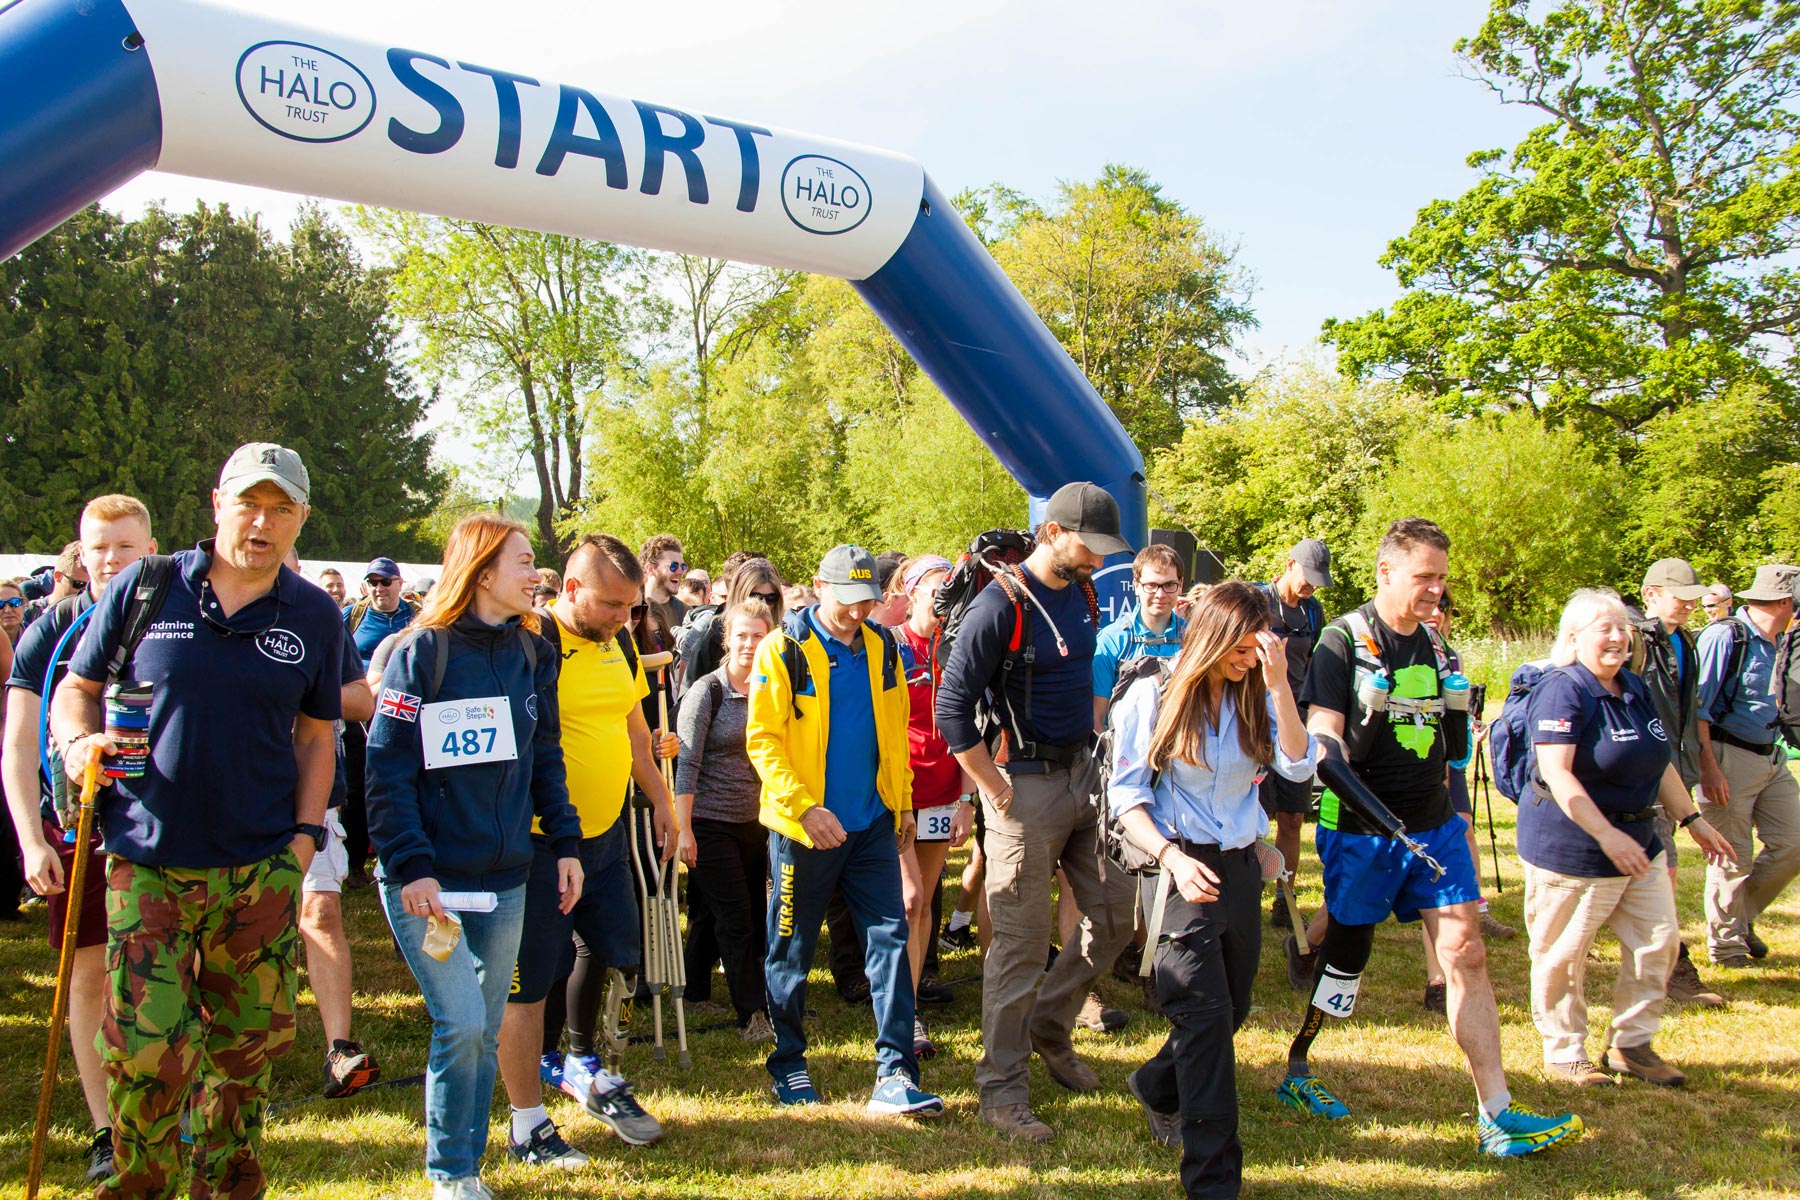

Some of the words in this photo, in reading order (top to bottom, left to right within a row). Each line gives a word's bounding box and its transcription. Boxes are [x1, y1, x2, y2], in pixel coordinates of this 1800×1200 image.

[291, 56, 319, 71] THE
[260, 65, 356, 110] HALO
[285, 105, 328, 124] TRUST
[386, 47, 773, 213] START
[816, 166, 834, 179] THE
[796, 176, 859, 209] HALO
[811, 206, 840, 221] TRUST
[849, 568, 872, 580] AUS
[1120, 580, 1135, 592] TH
[1096, 596, 1140, 622] HA
[150, 620, 195, 630] ndmine
[264, 635, 299, 656] HALO
[279, 634, 289, 642] THE
[272, 649, 288, 658] TRUST
[466, 712, 487, 720] Steps
[441, 727, 497, 757] 487
[928, 816, 951, 834] 38
[778, 863, 795, 937] UKRAINE
[1327, 993, 1355, 1011] 42
